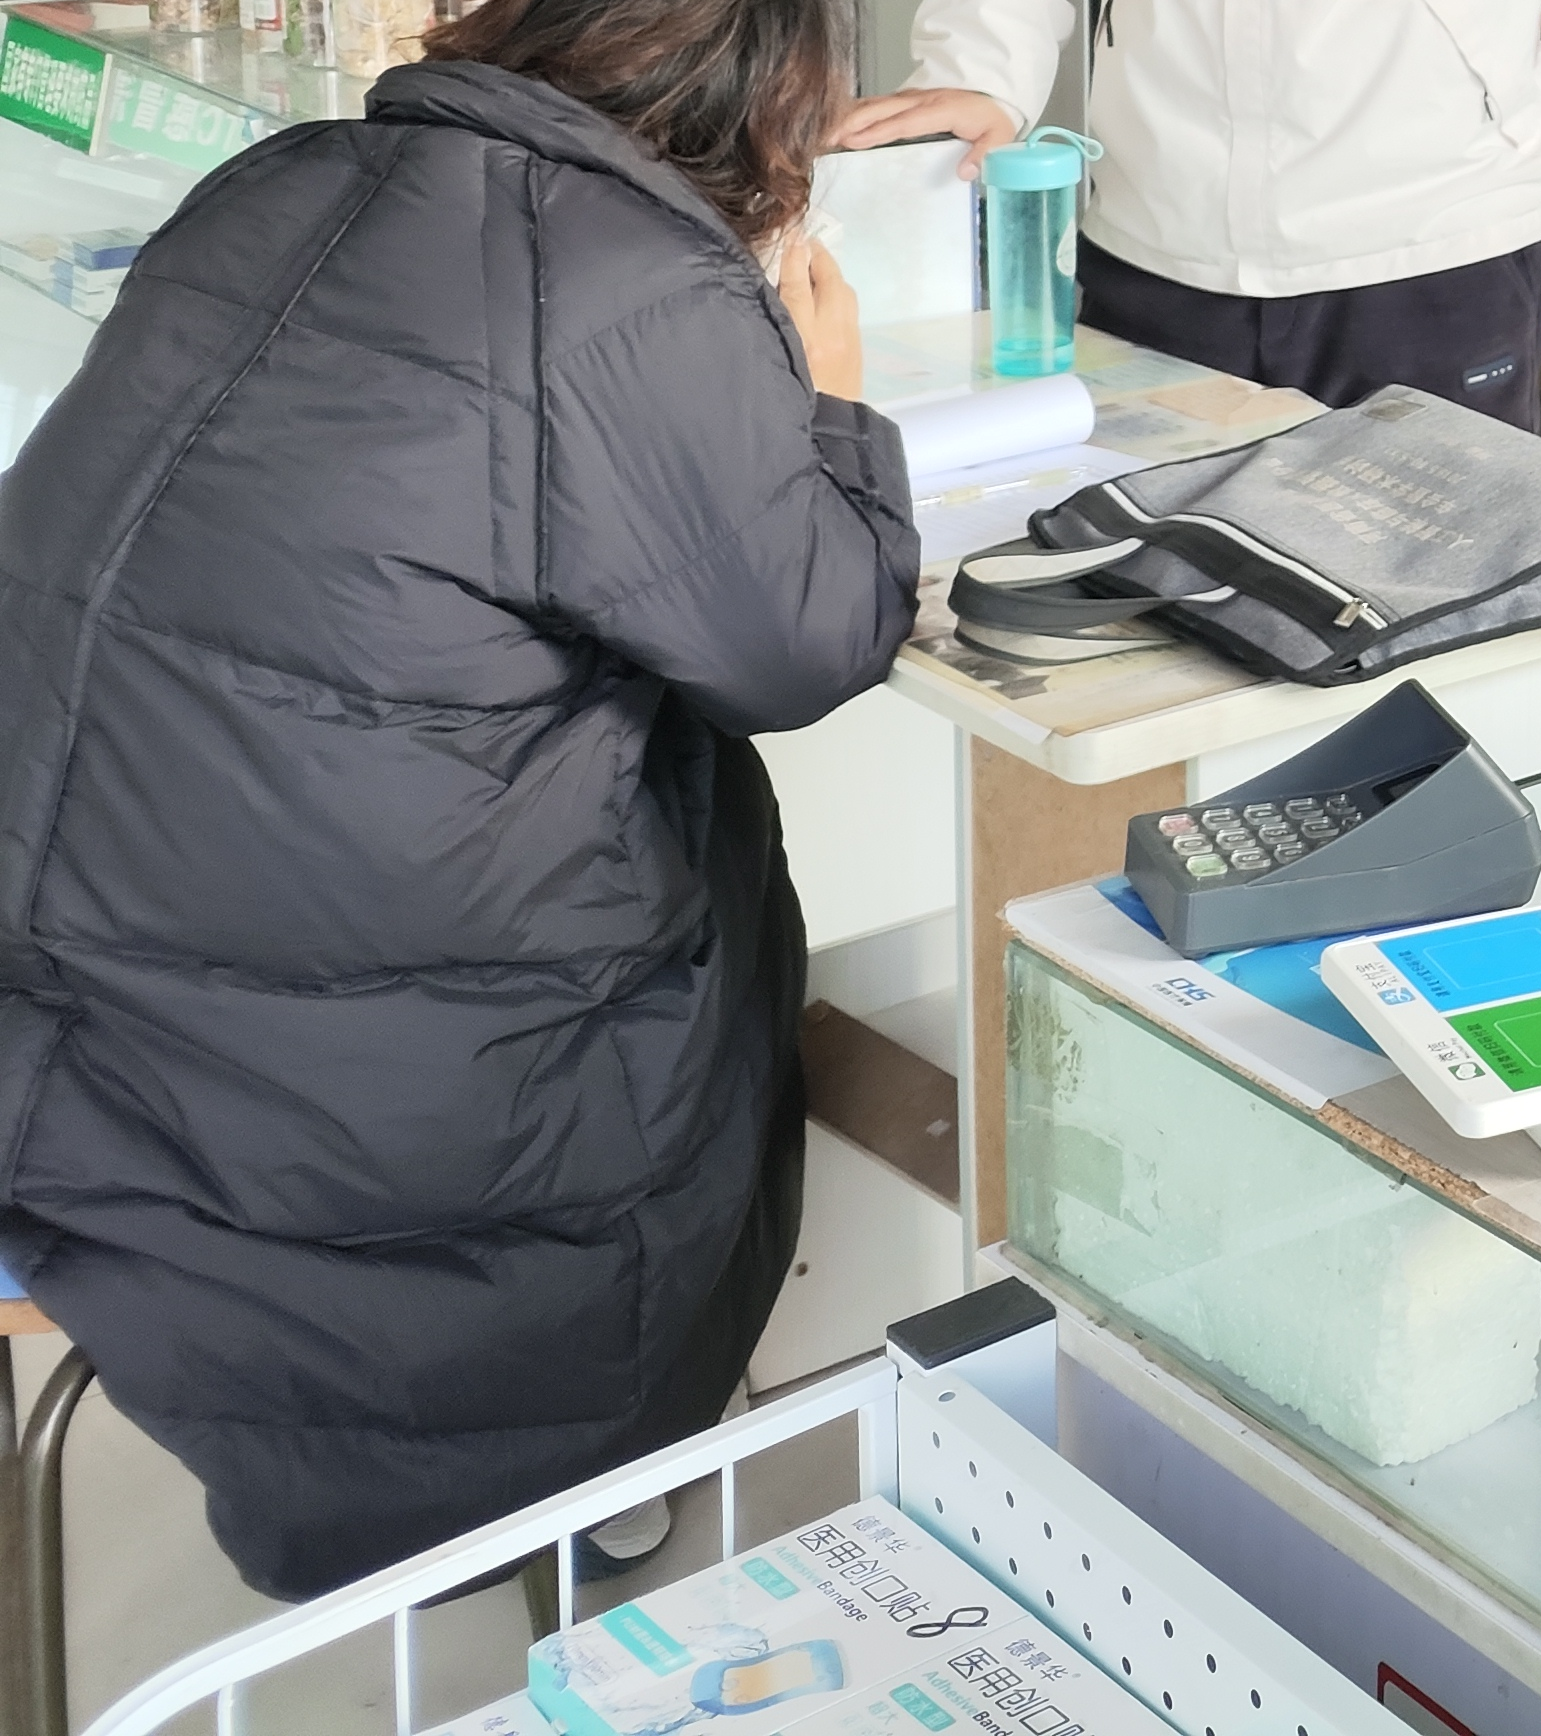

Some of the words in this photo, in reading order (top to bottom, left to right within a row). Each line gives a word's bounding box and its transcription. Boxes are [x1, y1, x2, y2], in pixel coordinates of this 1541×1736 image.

[850, 1514, 912, 1556] 德景华
[795, 1522, 931, 1623] 医用创口贴
[1004, 1637, 1070, 1683] 德景华
